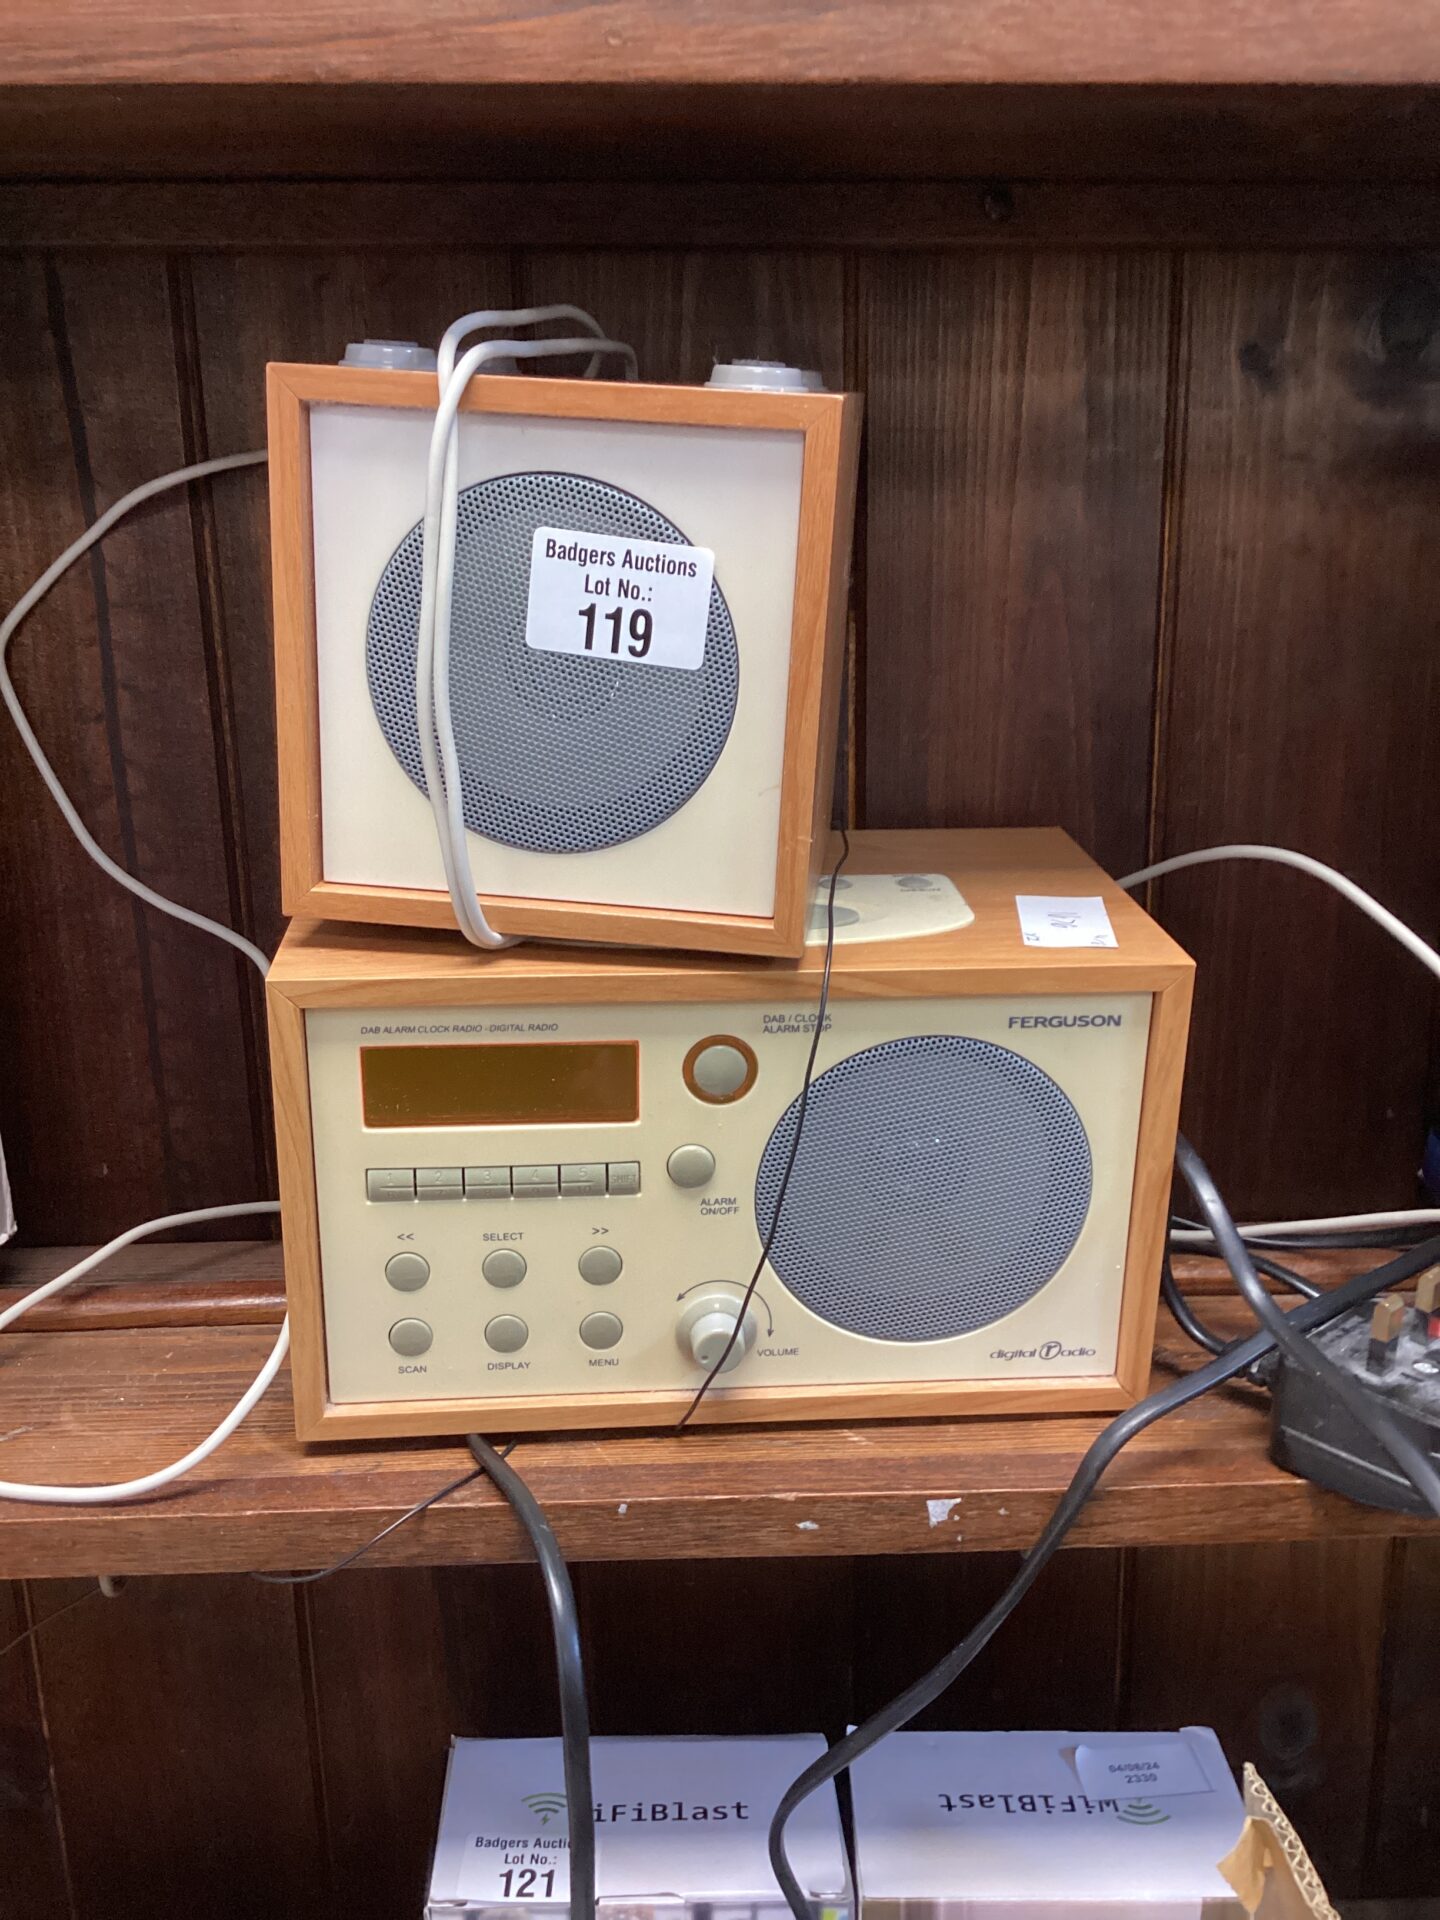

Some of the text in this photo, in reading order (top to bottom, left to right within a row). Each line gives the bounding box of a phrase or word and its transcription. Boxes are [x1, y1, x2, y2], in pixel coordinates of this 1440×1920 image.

[546, 538, 697, 577] Badgers Auctions
[584, 574, 652, 601] Lot No.:
[578, 603, 653, 657] 119
[763, 1014, 785, 1024] DAB
[1008, 1015, 1122, 1029] FERGUSON
[361, 1026, 381, 1034] DAB
[383, 1025, 416, 1034] ALARM
[418, 1025, 450, 1033] CLOCK
[452, 1024, 483, 1033] RADIO
[489, 1024, 525, 1032] DIGITAL
[528, 1023, 559, 1032] RADIO
[762, 1024, 800, 1034] ALARM
[700, 1197, 737, 1206] ALARM
[700, 1206, 740, 1216] ON/OFF
[482, 1232, 524, 1241] SELECT
[757, 1347, 800, 1357] VOLUME
[990, 1348, 1037, 1361] digital
[487, 1361, 531, 1371] DISPLAY
[588, 1358, 619, 1367] MENU
[398, 1365, 427, 1374] SCAN
[938, 1794, 1119, 1814] WiFiBlast
[594, 1801, 749, 1822] iFiBlast
[475, 1836, 571, 1850] Badgers Aucti
[504, 1853, 557, 1865] Lot No.:
[499, 1868, 555, 1897] 121
